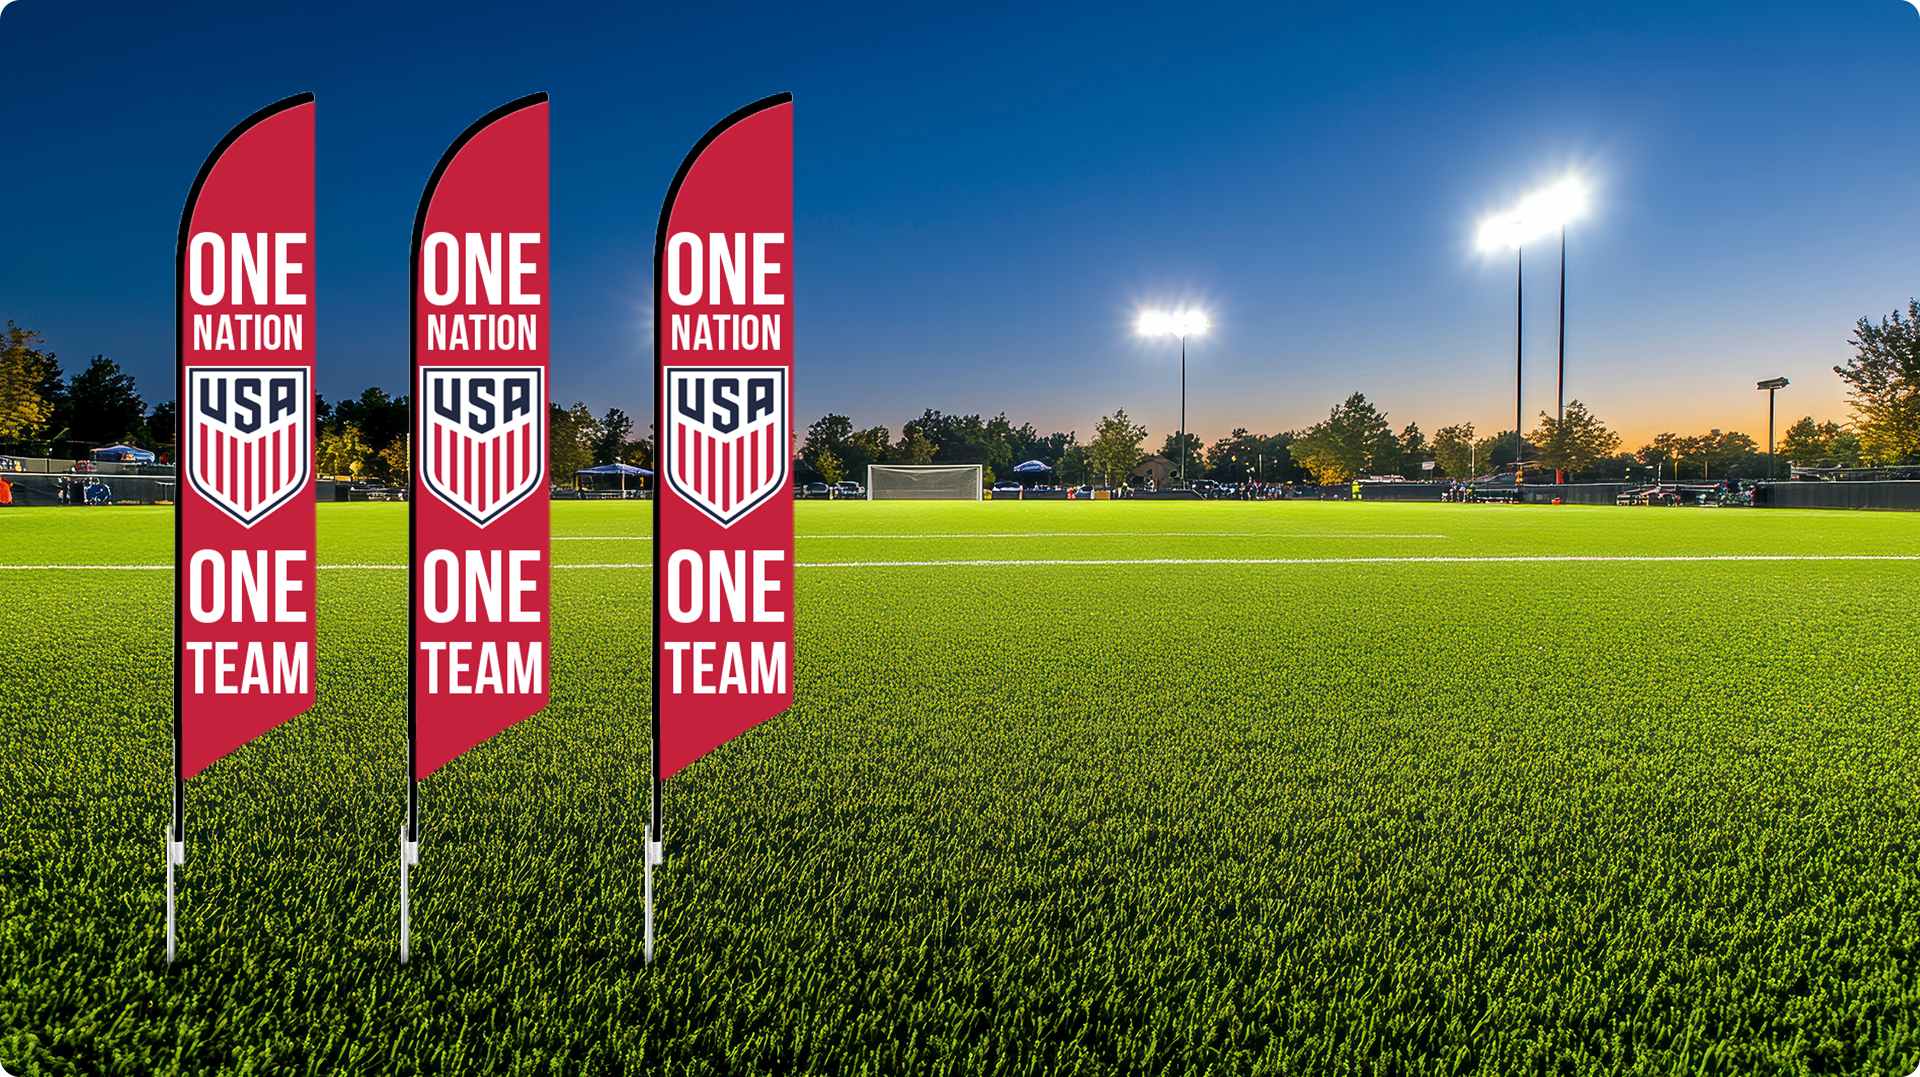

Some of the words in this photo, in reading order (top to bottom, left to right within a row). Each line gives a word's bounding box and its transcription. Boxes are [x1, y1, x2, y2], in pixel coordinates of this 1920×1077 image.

[190, 232, 306, 306] ONE
[424, 232, 540, 306] ONE
[668, 232, 784, 306] ONE
[193, 314, 303, 351] NATION
[427, 314, 537, 351] NATION
[671, 314, 781, 351] NATION
[200, 378, 296, 434] USA
[434, 378, 530, 434] USA
[678, 378, 774, 434] USA
[190, 549, 306, 624] ONE
[424, 549, 540, 624] ONE
[668, 549, 784, 624] ONE
[187, 641, 308, 694] TEAM
[421, 641, 542, 694] TEAM
[665, 641, 786, 694] TEAM
